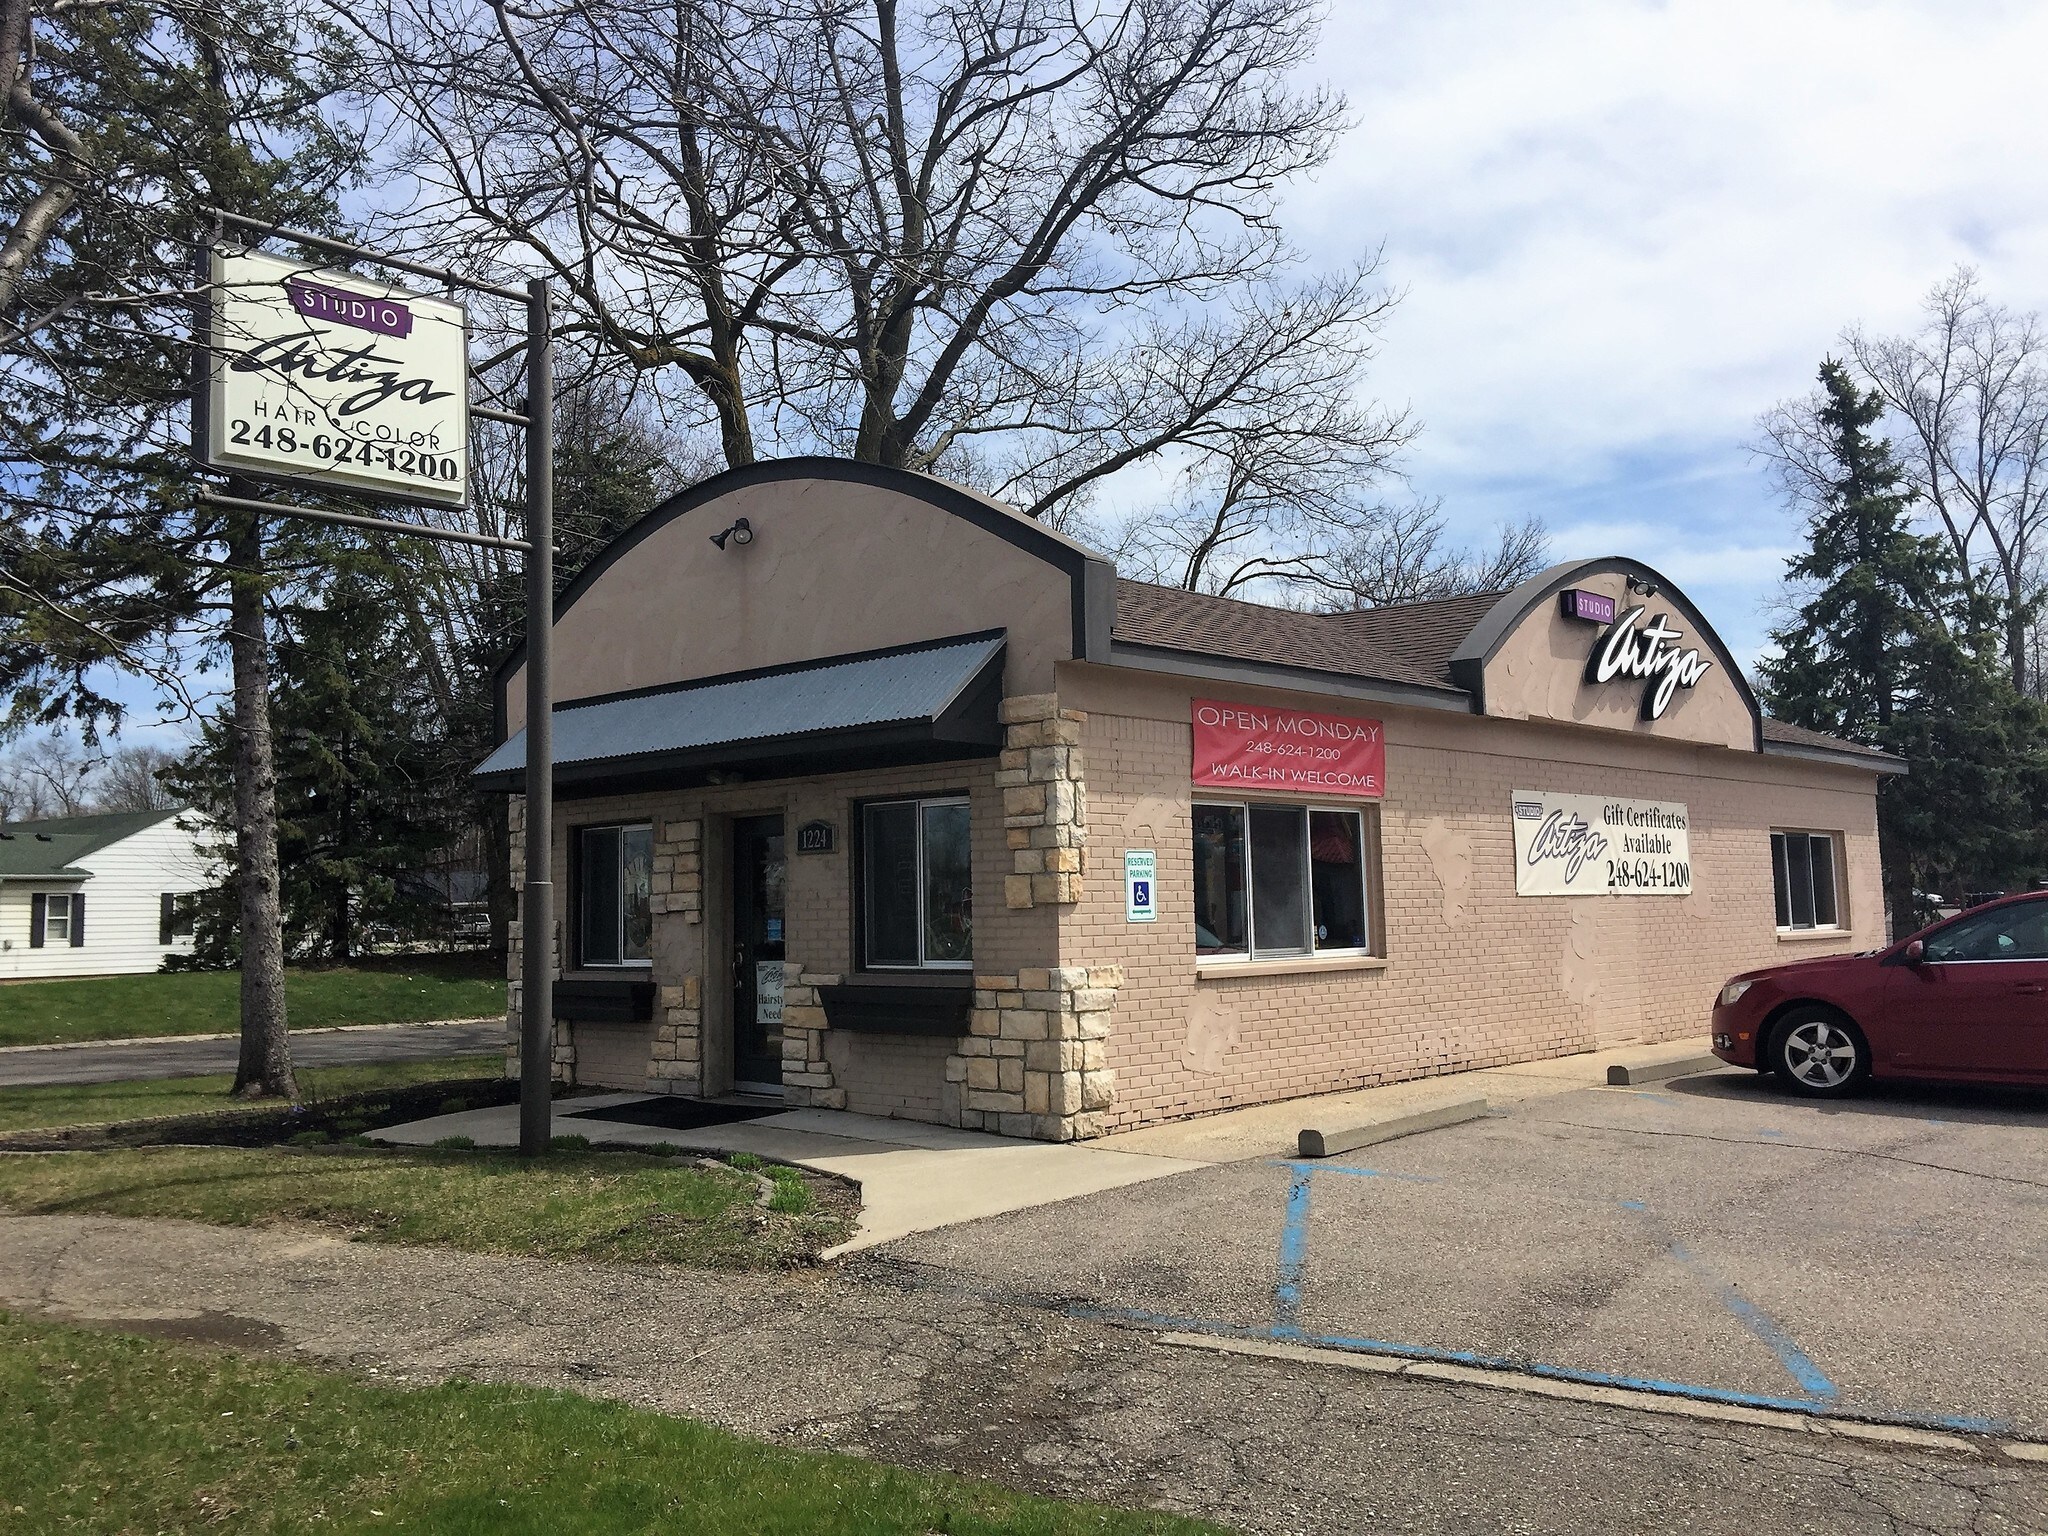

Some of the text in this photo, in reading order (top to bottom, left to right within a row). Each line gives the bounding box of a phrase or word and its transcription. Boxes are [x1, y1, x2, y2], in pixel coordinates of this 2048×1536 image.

[303, 289, 398, 327] STUDIO
[253, 400, 440, 450] HAIR COLOR
[230, 418, 458, 480] 248-624-1200
[1578, 598, 1612, 618] STUDIO
[1596, 604, 1714, 719] Artiza
[1197, 706, 1380, 743] OPEN MONDAY
[1245, 740, 1341, 761] 248-624-1200
[1211, 762, 1375, 787] WALK-IN WELCOME
[1518, 805, 1541, 817] STUDIO
[1603, 803, 1687, 831] Gift Certificates
[802, 829, 826, 849] 1224
[1623, 833, 1672, 855] Available
[1127, 857, 1153, 866] RESERVED
[1129, 869, 1152, 878] PARKING
[1606, 857, 1690, 888] 248-624-1200
